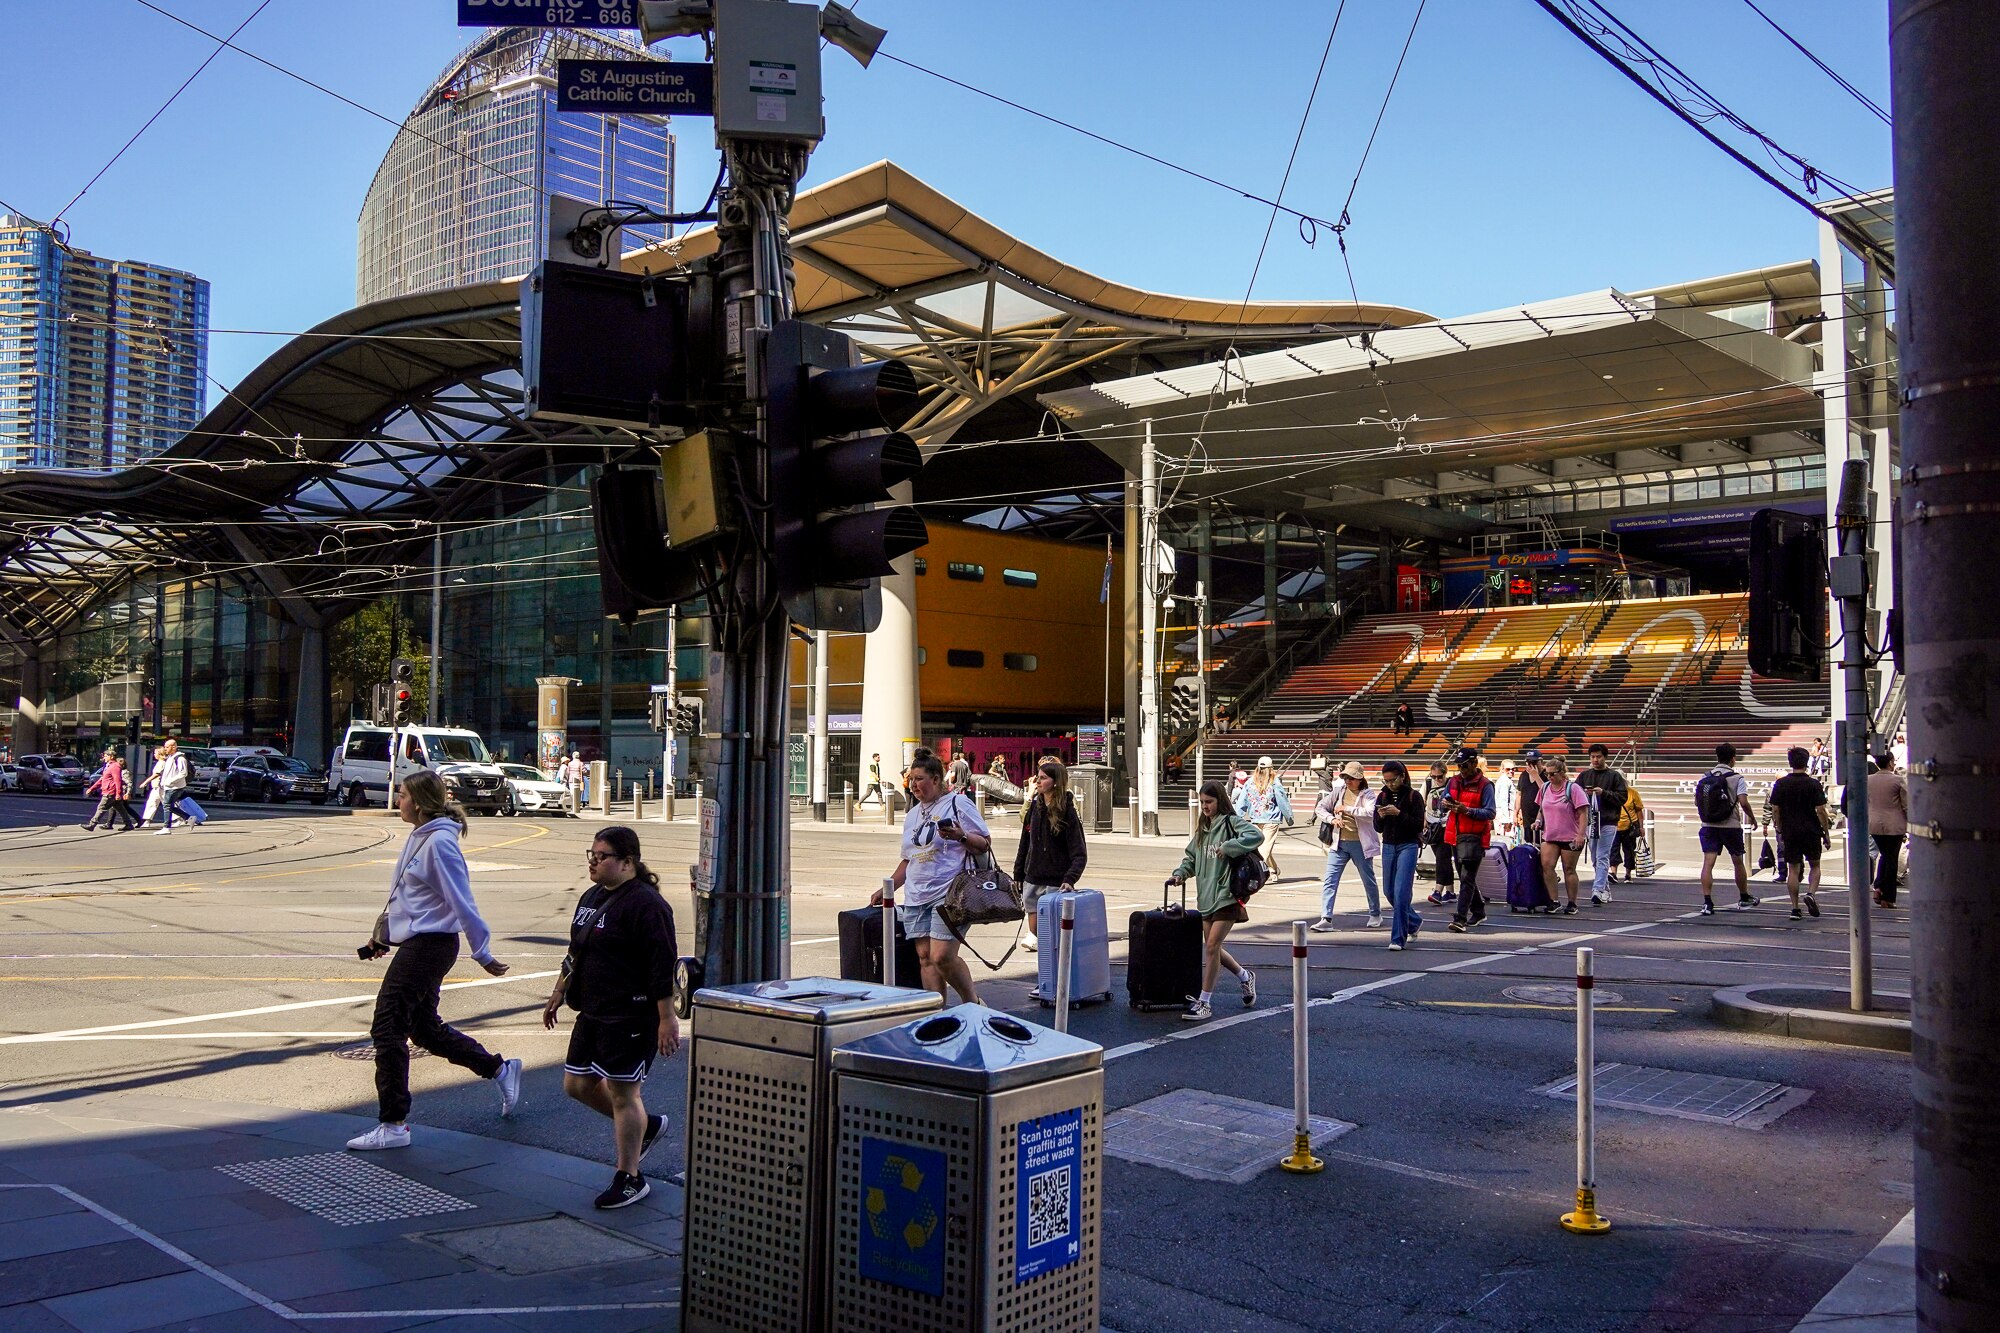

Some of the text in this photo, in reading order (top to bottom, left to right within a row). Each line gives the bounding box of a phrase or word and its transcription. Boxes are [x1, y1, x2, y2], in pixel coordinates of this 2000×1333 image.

[546, 8, 576, 24] 612
[598, 9, 632, 25] 696
[580, 68, 685, 88] St Augustine
[567, 85, 696, 103] Catholic Church
[832, 720, 848, 729] Cross
[1227, 740, 1305, 748] PART TWO
[1021, 1119, 1079, 1145] Scan to report
[1027, 1132, 1073, 1158] graffiti and
[1025, 1146, 1075, 1170] street waste
[872, 1249, 929, 1280] Recycling
